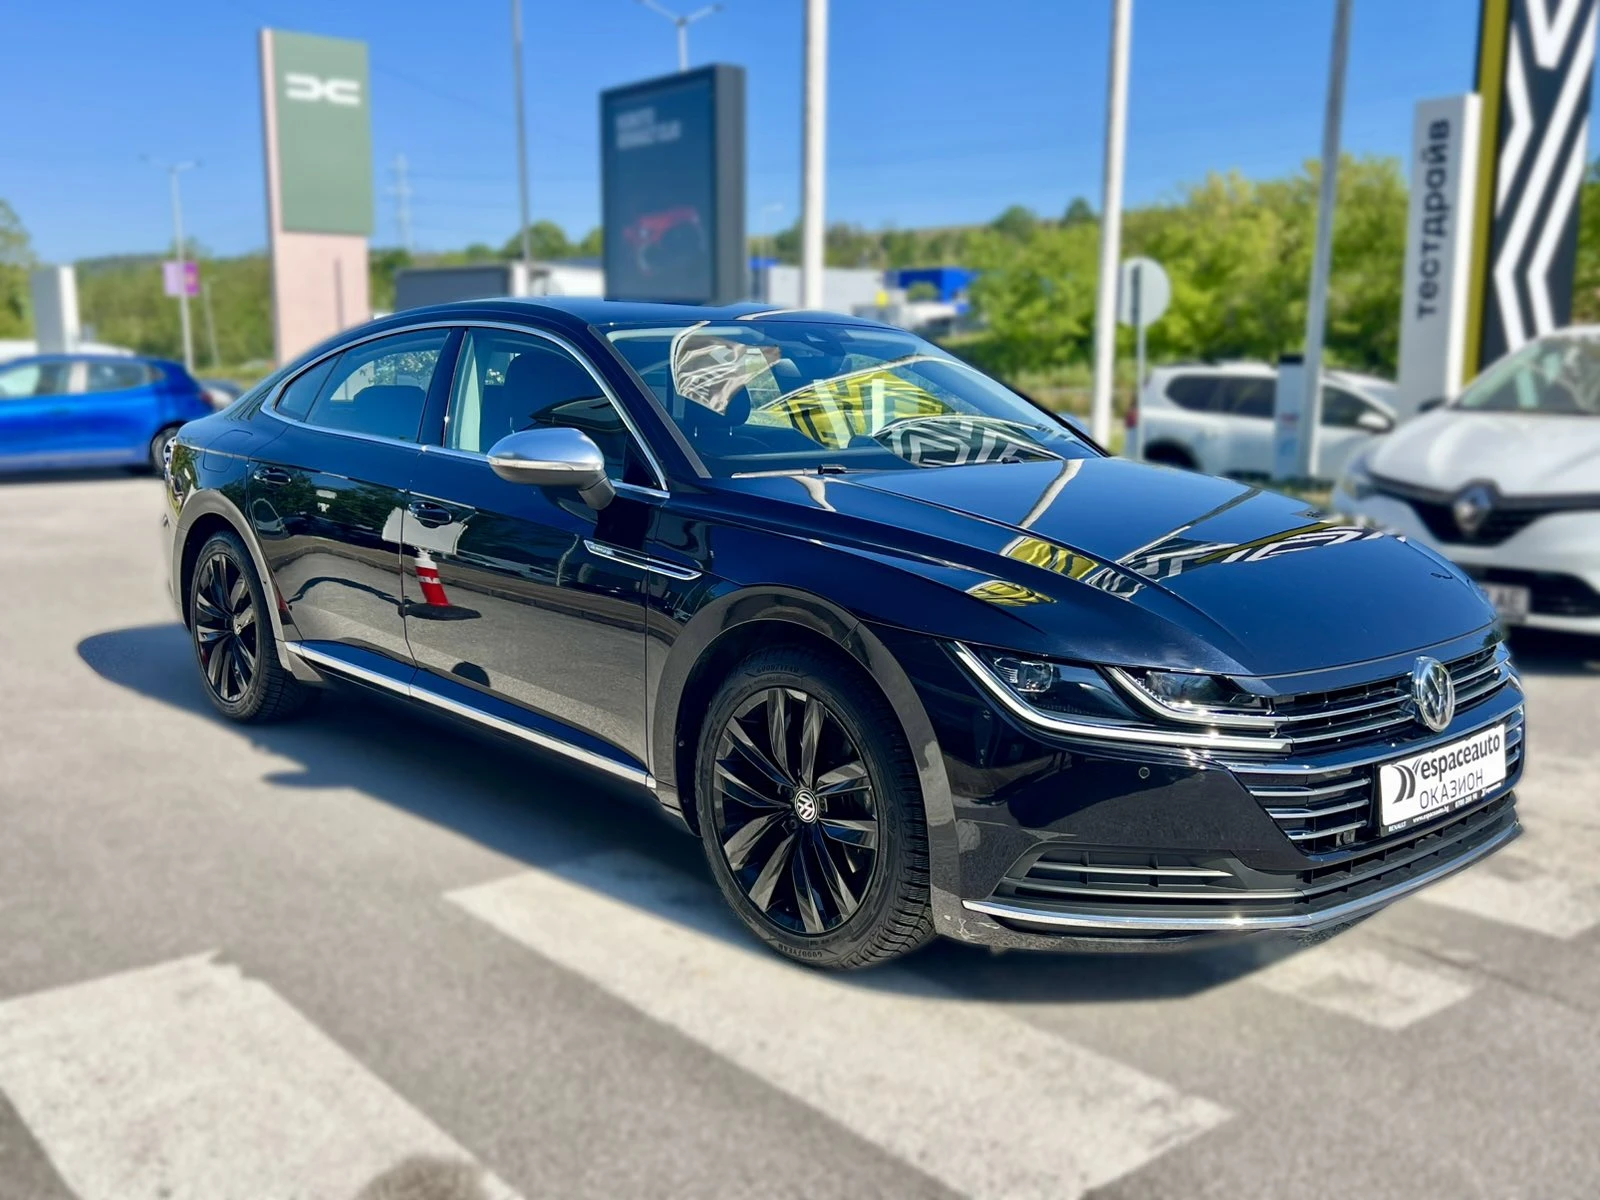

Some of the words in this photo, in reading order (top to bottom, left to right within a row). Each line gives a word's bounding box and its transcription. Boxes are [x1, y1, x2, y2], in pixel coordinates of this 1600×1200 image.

[1416, 118, 1452, 321] тестдрайв
[1420, 733, 1501, 782] espaceauto
[1419, 768, 1485, 810] ОКАЗИОН
